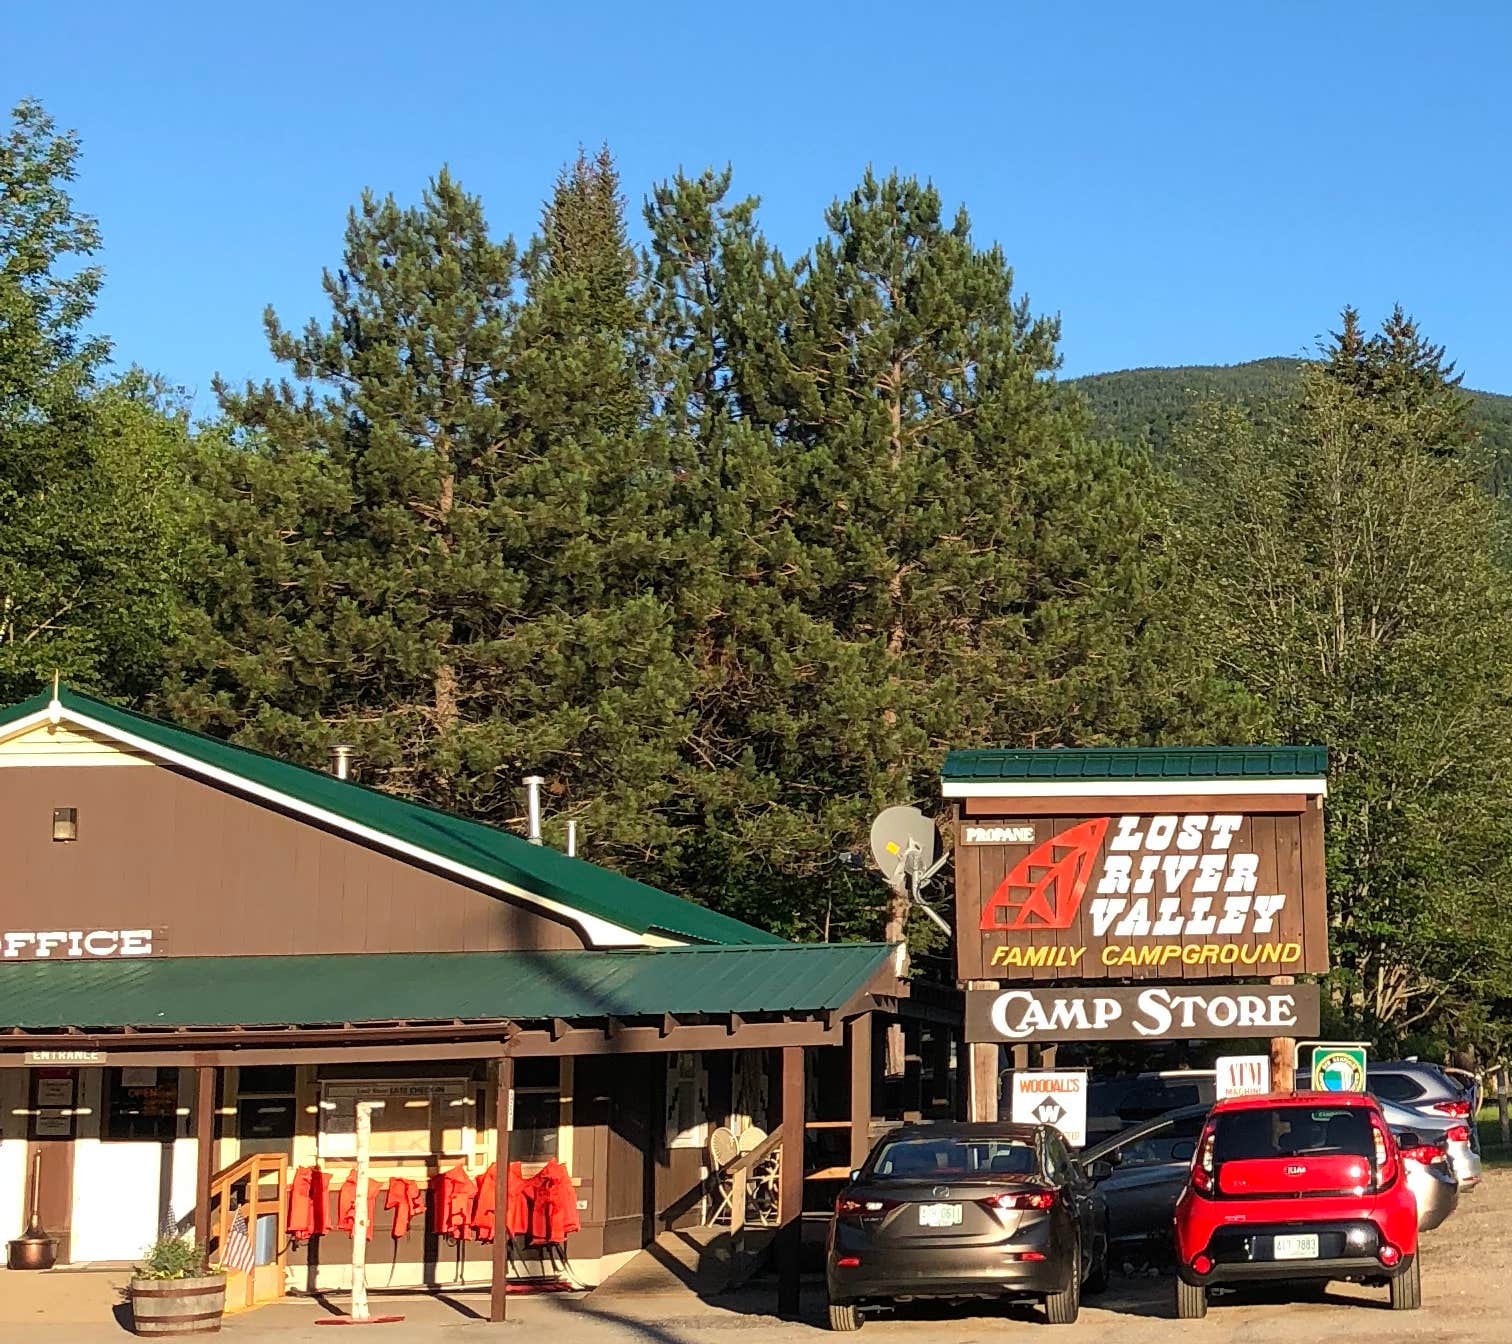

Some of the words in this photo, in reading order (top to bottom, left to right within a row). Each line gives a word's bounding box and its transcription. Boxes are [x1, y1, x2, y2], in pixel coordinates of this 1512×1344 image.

[966, 827, 1034, 842] PROPANE
[1110, 815, 1243, 851] LOST
[1096, 853, 1259, 894] RIVER
[1089, 894, 1286, 936] VALLEY
[0, 929, 153, 957] FFICE
[990, 945, 1087, 967] FAMILY
[1101, 942, 1302, 966] CAMPGROUND
[991, 990, 1122, 1038] CAMP
[1132, 988, 1298, 1036] STORE
[33, 1051, 99, 1060] ENTRANCE
[1020, 1078, 1080, 1093] WOODALL'S
[1228, 1062, 1261, 1087] ATM
[1038, 1104, 1061, 1123] W
